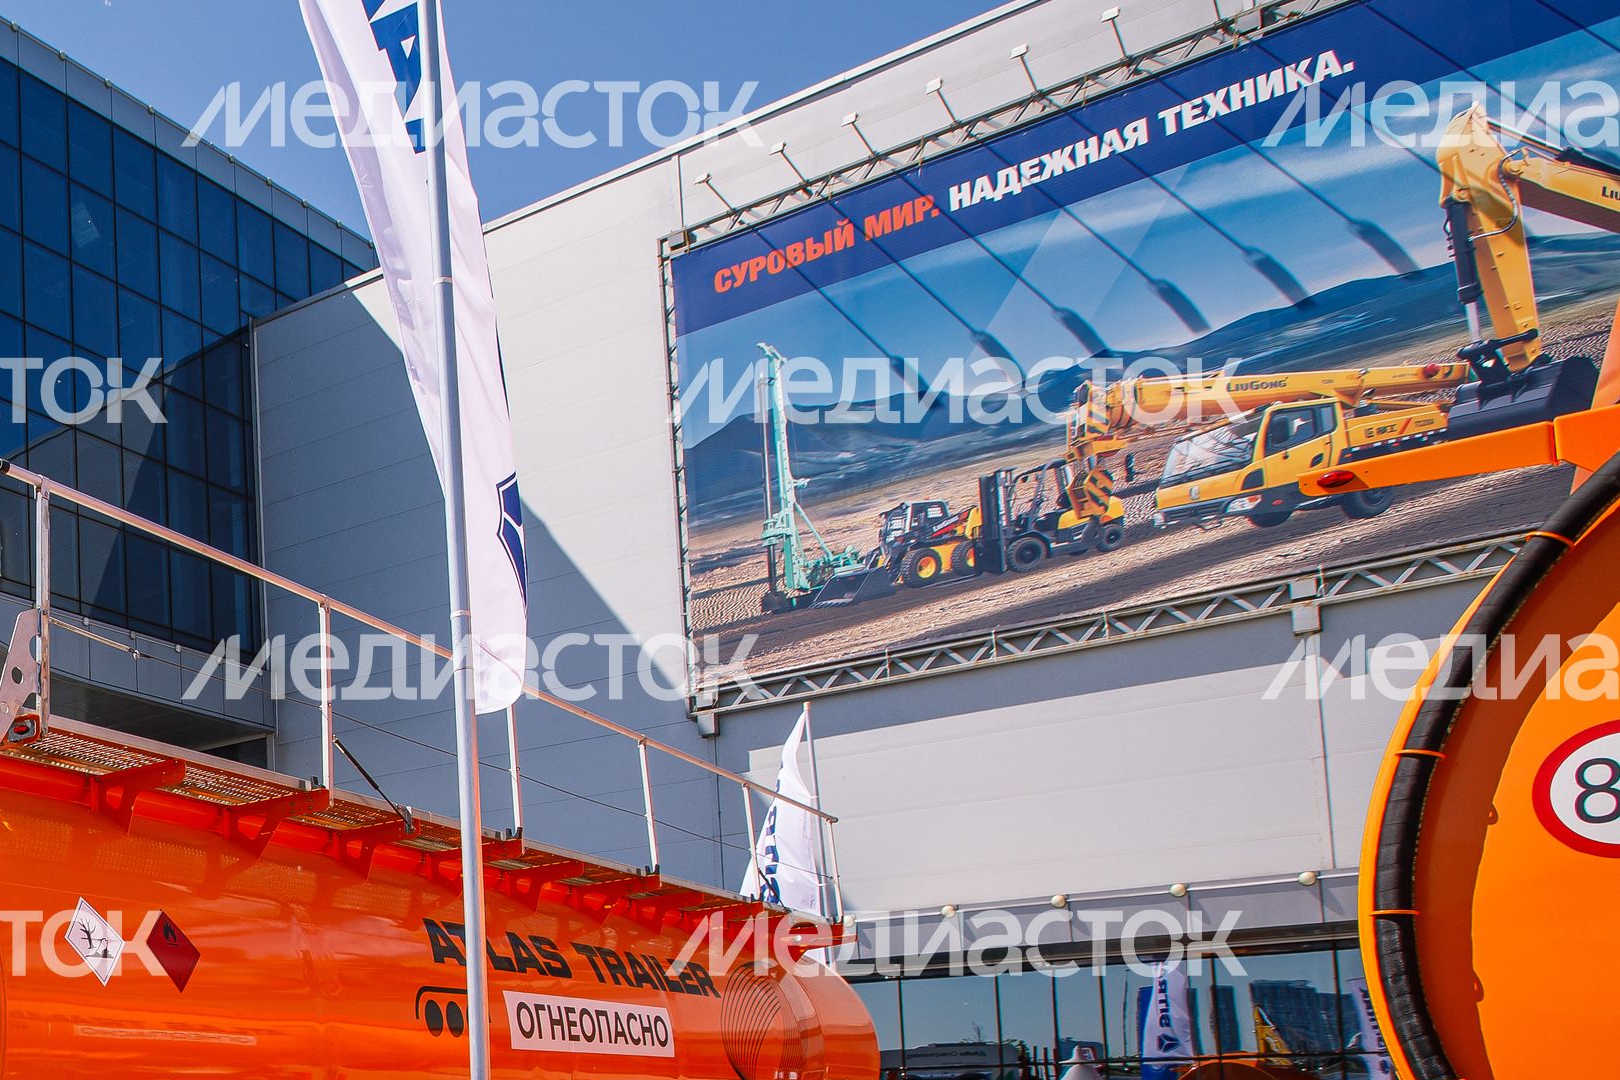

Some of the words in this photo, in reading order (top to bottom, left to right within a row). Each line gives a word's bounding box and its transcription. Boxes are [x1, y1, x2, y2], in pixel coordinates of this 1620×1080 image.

[713, 217, 856, 294] СУРОВЫЙ
[864, 194, 940, 243] МИР.
[949, 116, 1150, 213] НАДЕЖНАЯ
[1158, 50, 1356, 137] ТЕХНИКА.
[1573, 757, 1620, 824] 8
[571, 942, 721, 998] TRAILER
[516, 1001, 669, 1048] ОГНЕОПАСНО
